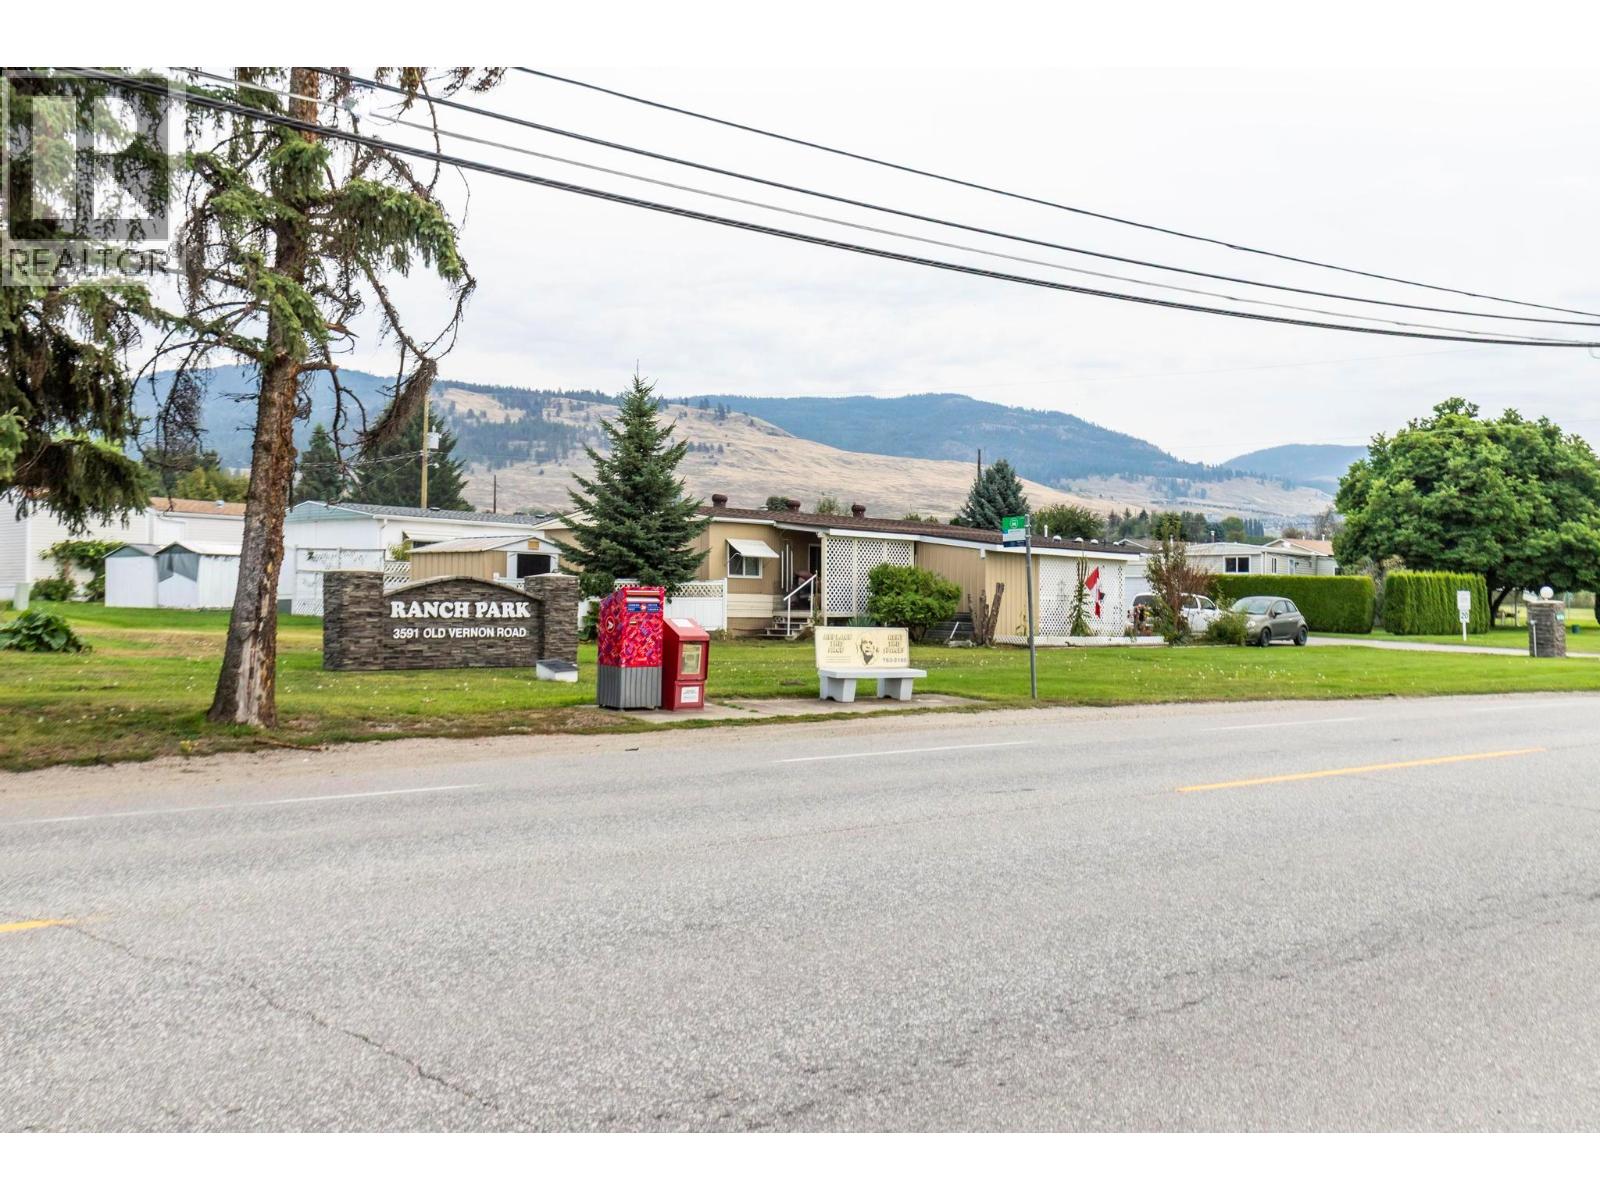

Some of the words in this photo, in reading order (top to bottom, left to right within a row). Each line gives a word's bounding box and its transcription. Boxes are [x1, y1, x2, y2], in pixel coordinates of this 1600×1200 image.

[390, 601, 470, 618] RANCH
[474, 601, 531, 618] PARK
[393, 628, 419, 639] 3591
[423, 628, 446, 638] OLD
[448, 627, 495, 638] VERNON
[497, 627, 527, 638] ROAD
